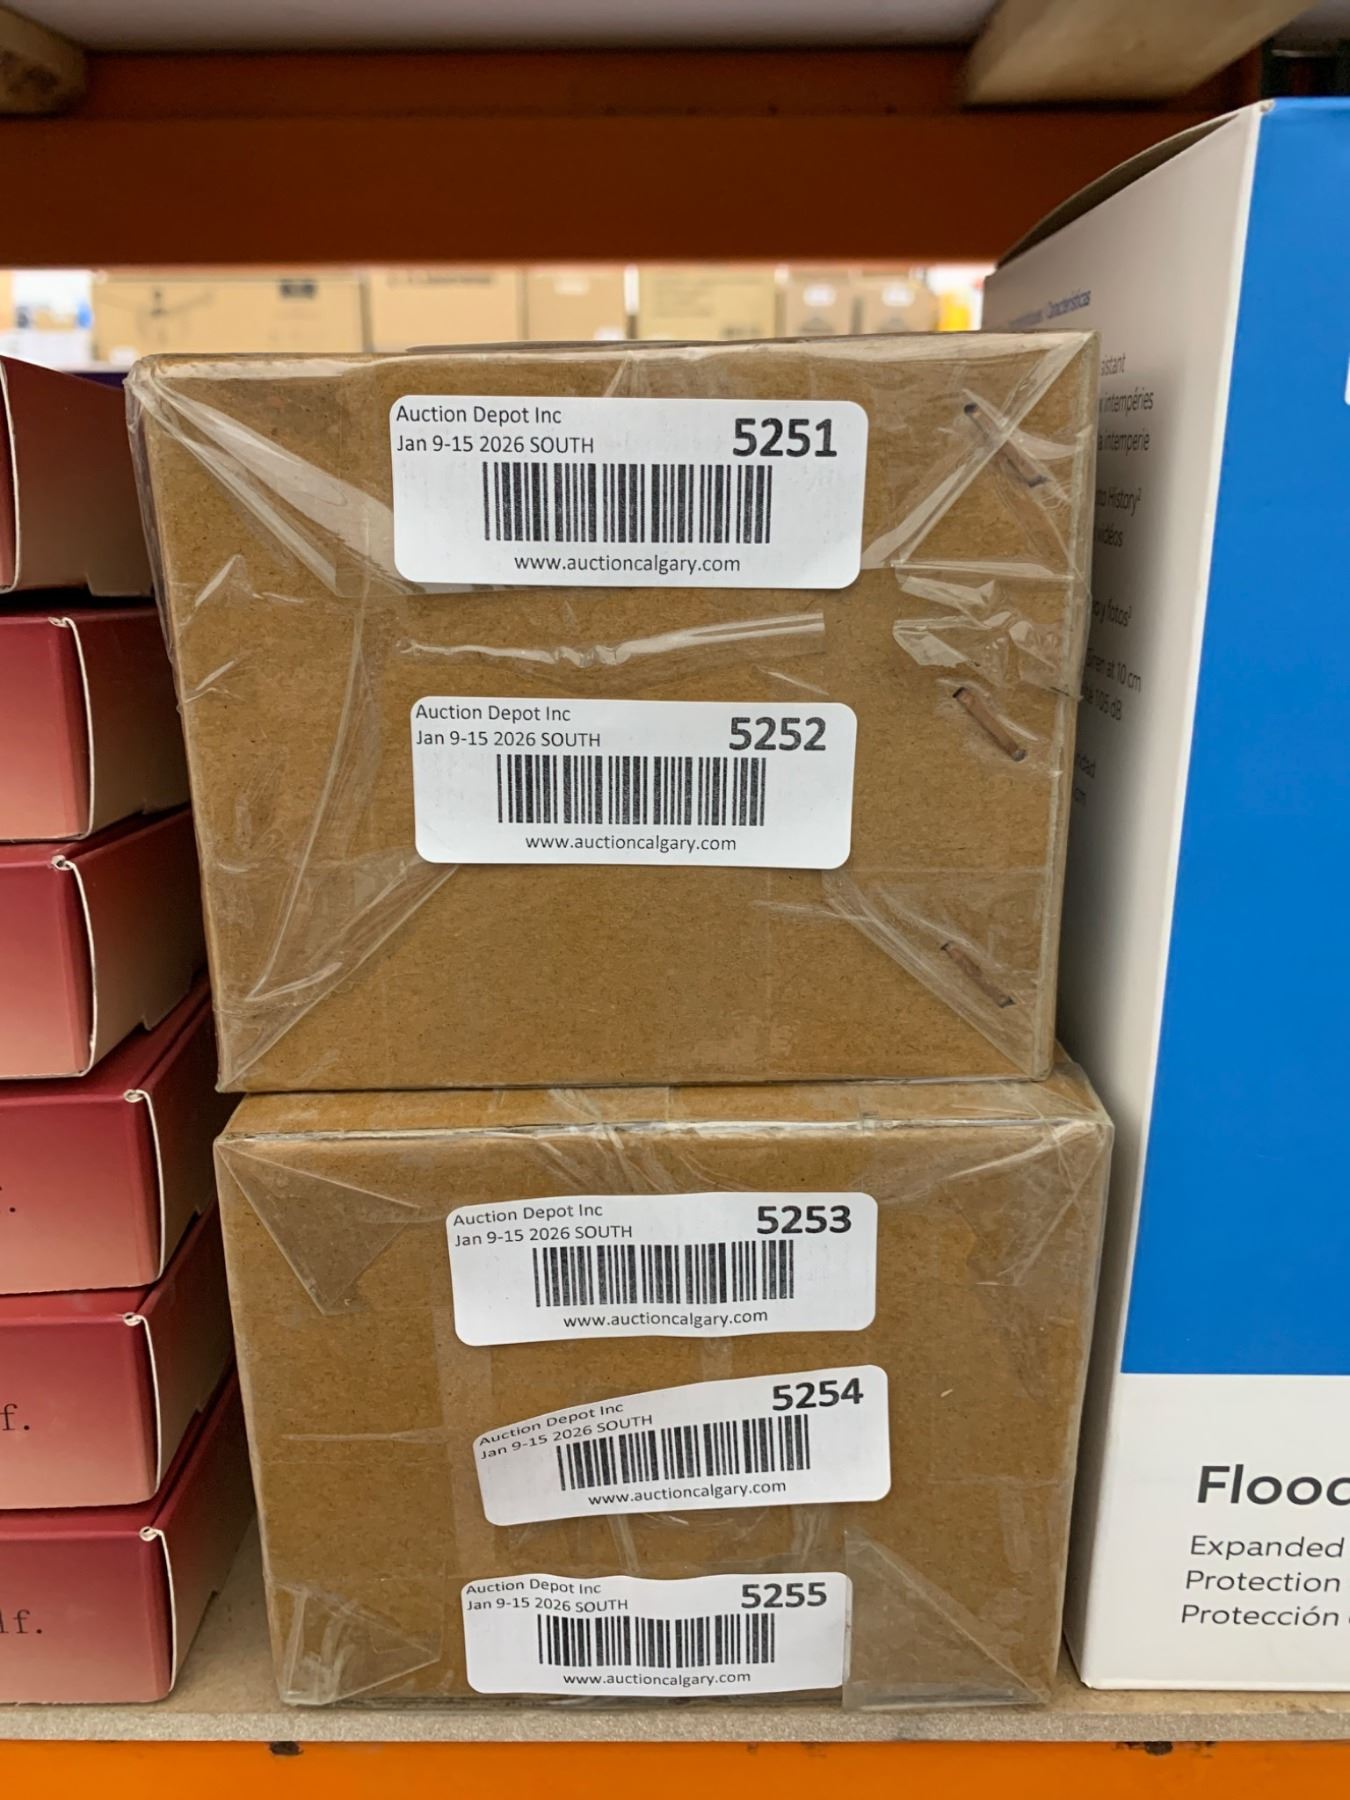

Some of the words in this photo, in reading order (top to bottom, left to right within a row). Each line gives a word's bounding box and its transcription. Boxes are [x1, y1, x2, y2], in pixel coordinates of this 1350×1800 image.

[396, 405, 467, 423] Auction
[473, 405, 530, 428] Depot
[535, 406, 562, 424] Inc
[396, 434, 427, 453] Jan
[432, 434, 474, 453] 9-15
[479, 435, 525, 453] 2026
[529, 436, 594, 454] SOUTH
[732, 417, 838, 458] 5251
[514, 553, 741, 575] www.auctioncalgary.com
[415, 703, 484, 721] Auction
[488, 704, 541, 723] Depot
[546, 706, 571, 722] Inc
[416, 730, 445, 746] Jan
[451, 730, 489, 746] 9-15
[493, 731, 536, 747] 2026
[540, 732, 601, 749] SOUTH
[728, 716, 828, 752] 5252
[525, 834, 737, 854] www.auctioncalgary.com
[453, 1209, 518, 1227] Auction
[523, 1205, 574, 1221] Depot
[578, 1203, 603, 1217] Inc
[756, 1204, 852, 1235] 5253
[455, 1234, 482, 1247] Jan
[486, 1228, 524, 1244] 9-15
[529, 1226, 571, 1241] 2026
[574, 1225, 633, 1240] SOUTH
[563, 1310, 769, 1329] www.auctioncalgary.com
[771, 1377, 865, 1411] 5254
[479, 1421, 542, 1447] Auction
[545, 1408, 596, 1426] Depot
[600, 1403, 624, 1416] Inc
[480, 1445, 508, 1460] Jan
[511, 1433, 549, 1452] 9-15
[552, 1424, 593, 1443] 2026
[596, 1414, 653, 1434] SOUTH
[588, 1480, 787, 1506] www.auctioncalgary.com
[1190, 1534, 1345, 1560] Expanded
[465, 1580, 525, 1595] Auction
[529, 1578, 575, 1594] Depot
[579, 1584, 602, 1595] Inc
[1185, 1569, 1341, 1593] Protection
[467, 1600, 492, 1611] Jan
[495, 1596, 531, 1609] 9-15
[534, 1597, 572, 1613] 2026
[574, 1599, 629, 1613] SOUTH
[740, 1581, 828, 1609] 5255
[1180, 1603, 1340, 1627] Protección
[562, 1671, 752, 1688] www.auctioncalgary.com
